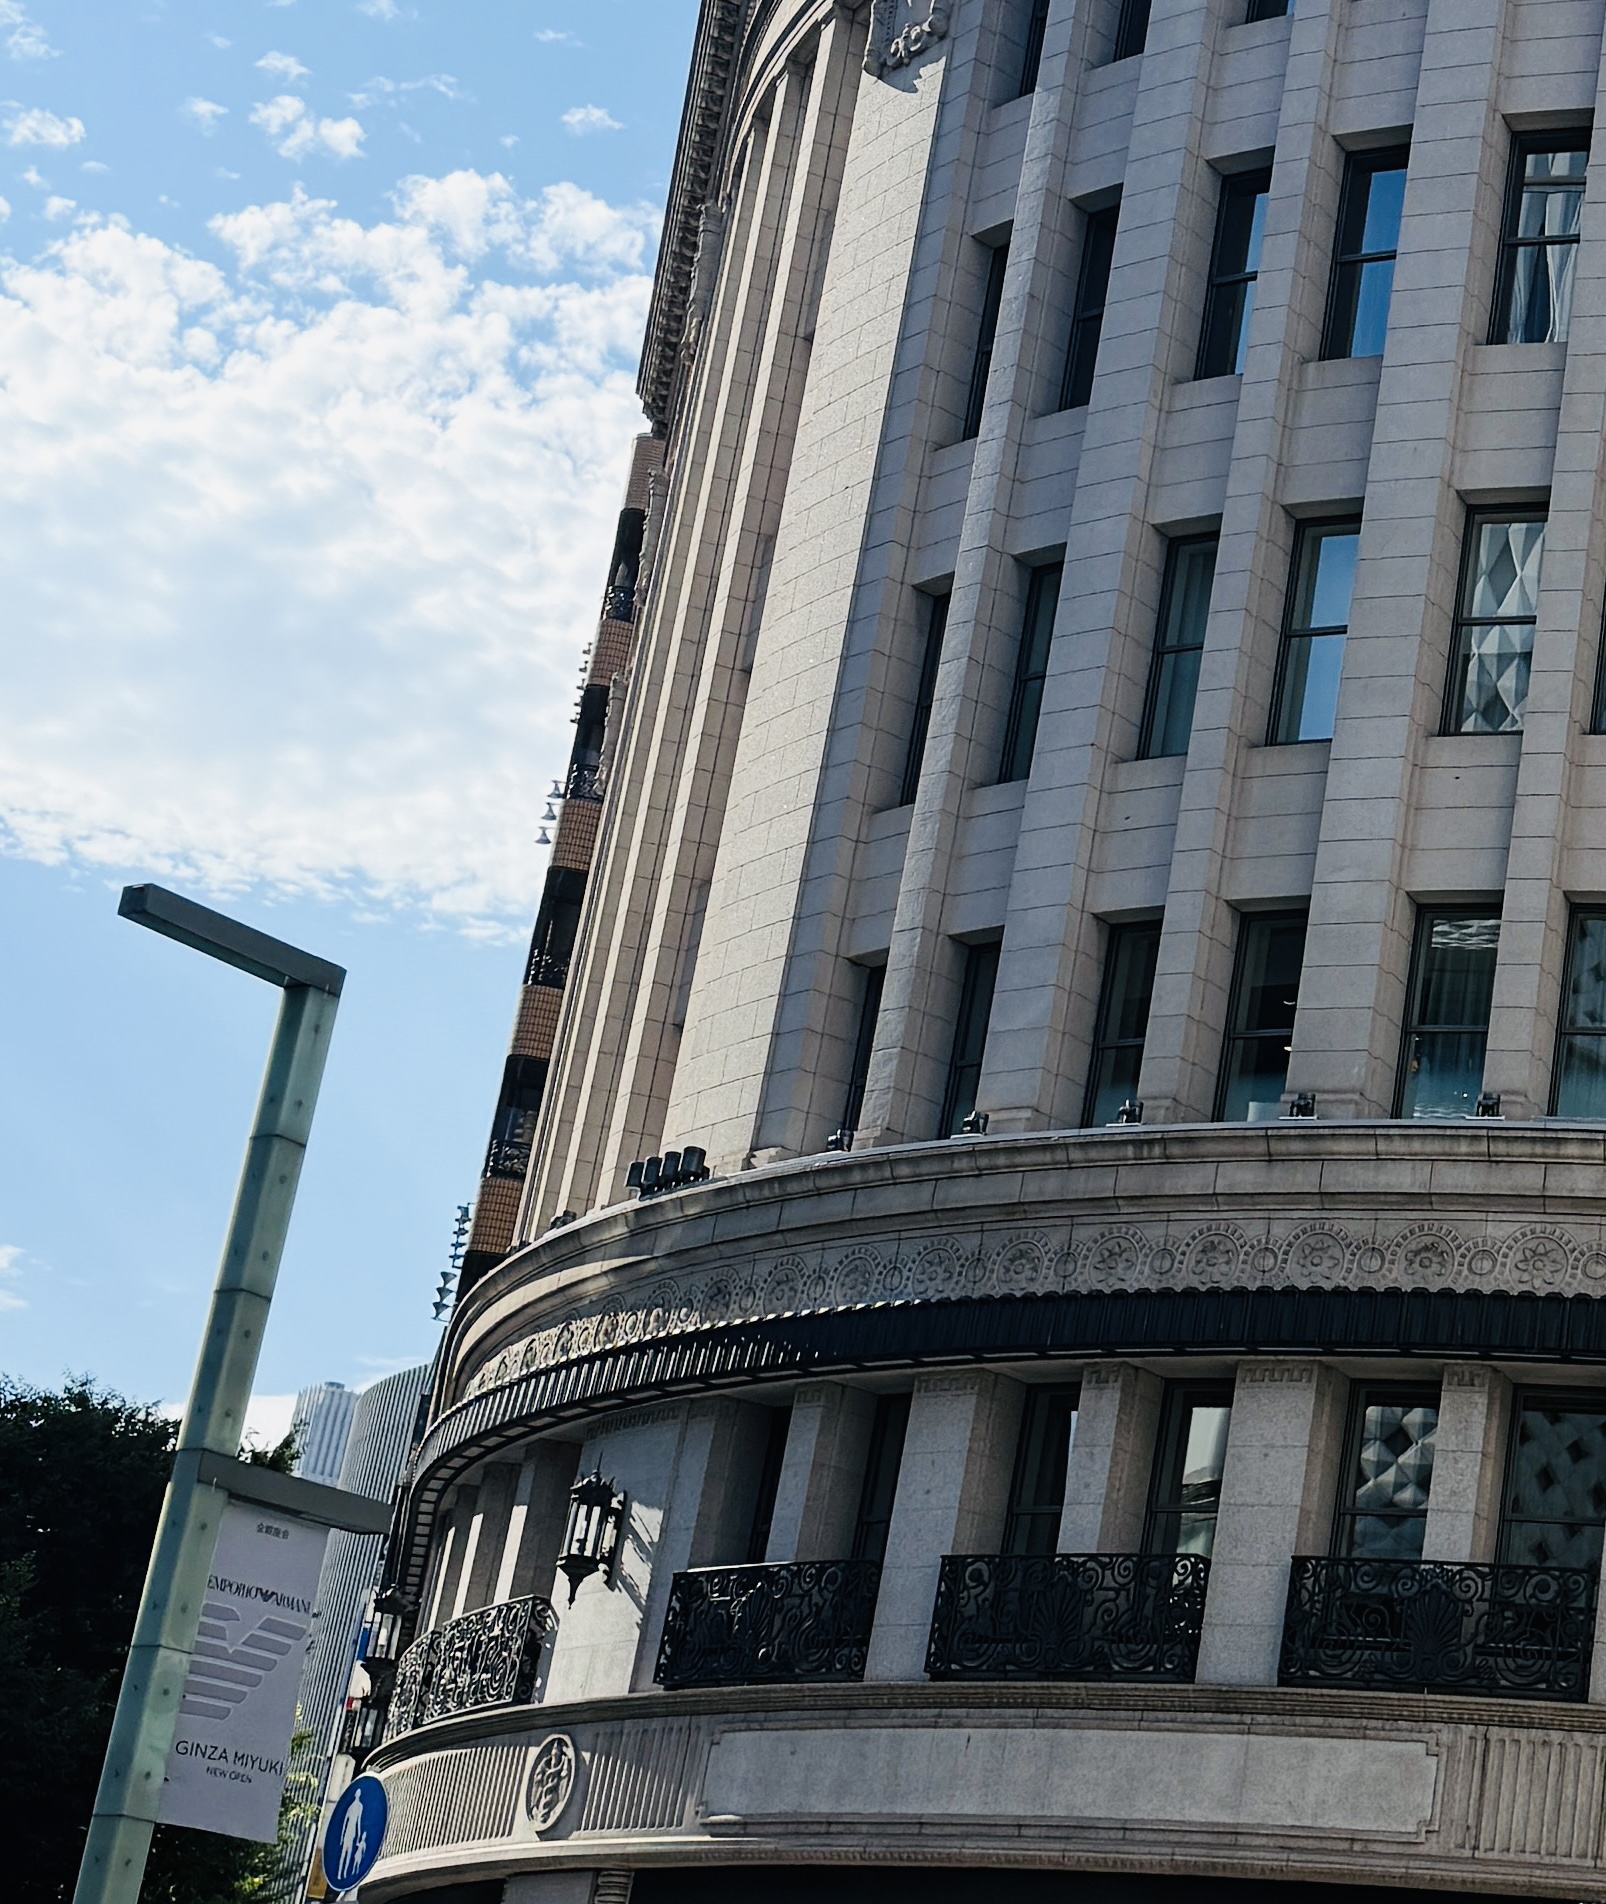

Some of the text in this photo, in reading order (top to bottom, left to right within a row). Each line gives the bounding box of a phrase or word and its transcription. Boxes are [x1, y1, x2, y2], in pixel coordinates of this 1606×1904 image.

[207, 1574, 311, 1615] EMPORIO ARMANI
[175, 1740, 284, 1776] GINZA MIYUKI
